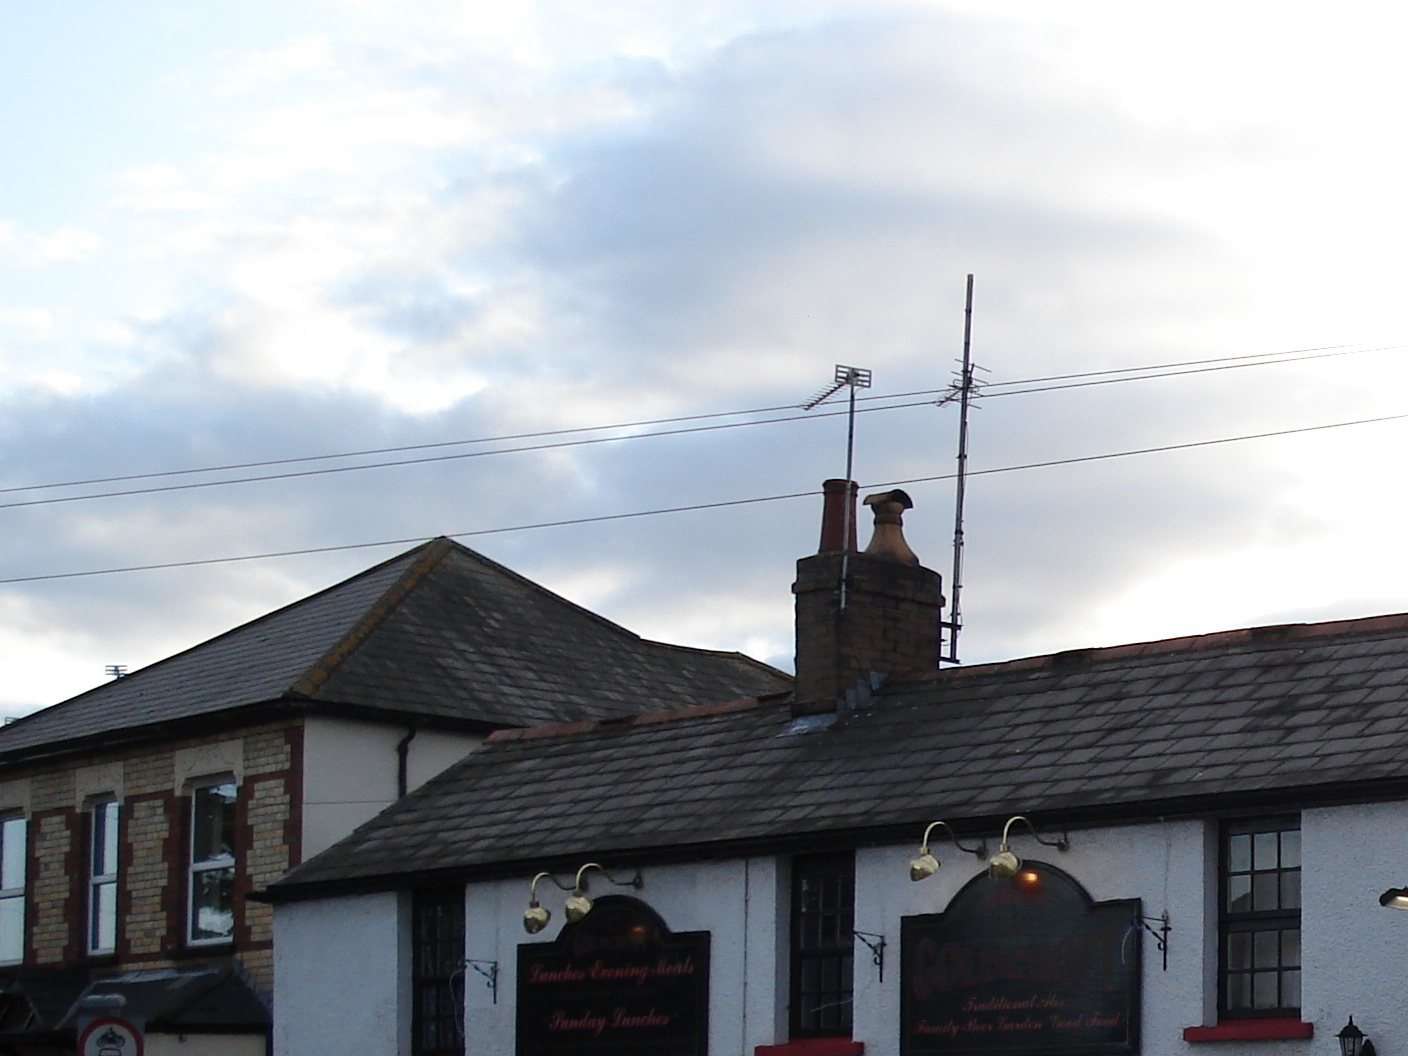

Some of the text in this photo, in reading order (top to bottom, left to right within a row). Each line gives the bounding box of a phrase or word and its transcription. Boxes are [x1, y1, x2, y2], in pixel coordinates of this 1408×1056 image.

[528, 955, 695, 985] Lunches Evening Meals
[962, 995, 1037, 1012] Traditional
[547, 1007, 670, 1037] Sunday Lunches
[912, 1019, 960, 1039] Family
[997, 1017, 1043, 1031] Garden
